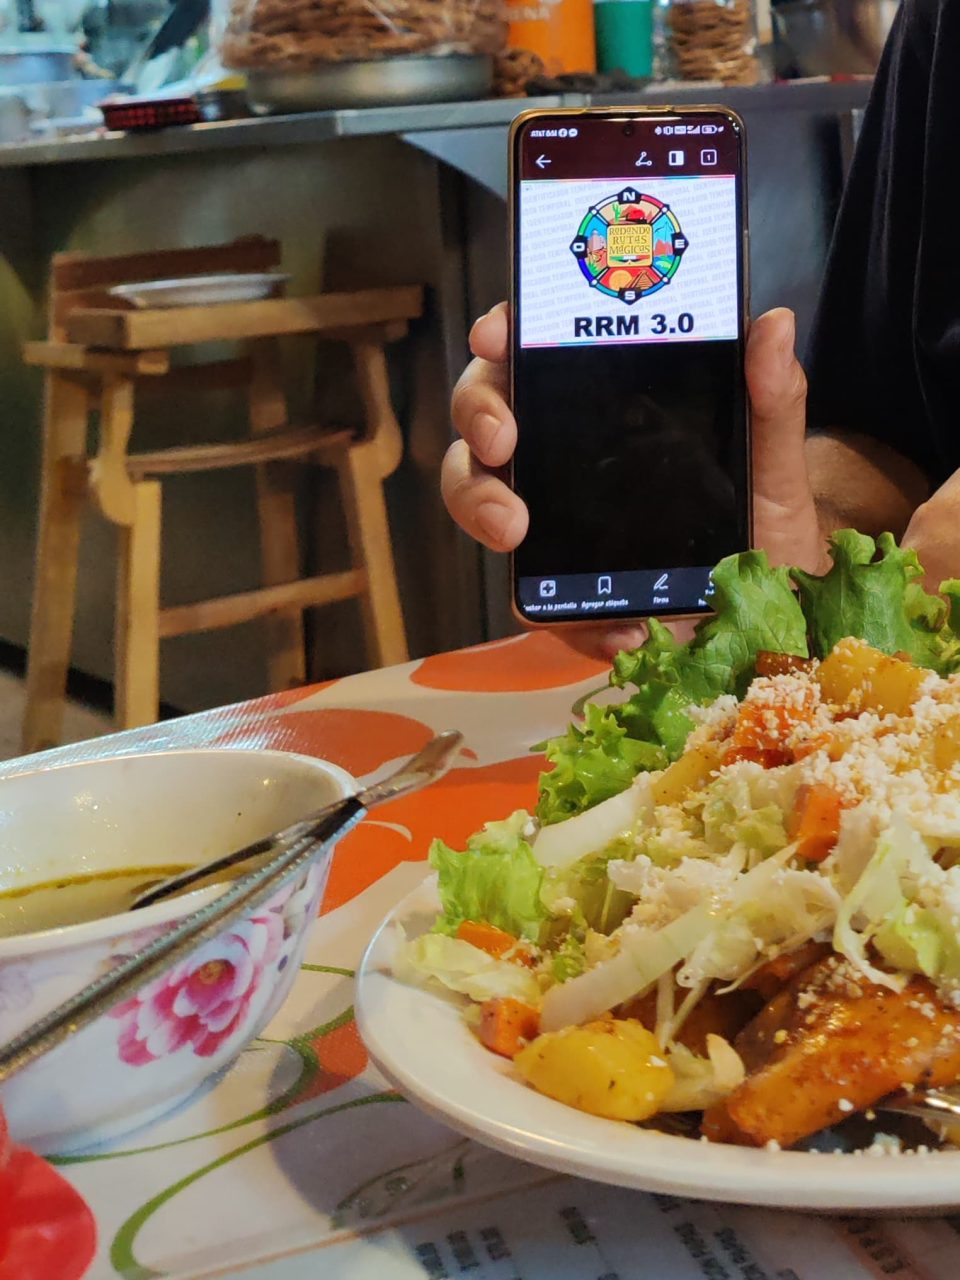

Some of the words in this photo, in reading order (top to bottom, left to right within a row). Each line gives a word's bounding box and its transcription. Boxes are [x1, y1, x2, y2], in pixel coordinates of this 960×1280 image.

[623, 191, 636, 202] N
[675, 238, 685, 249] E
[624, 290, 636, 301] S
[574, 315, 640, 337] RRM
[650, 312, 694, 334] 3.0
